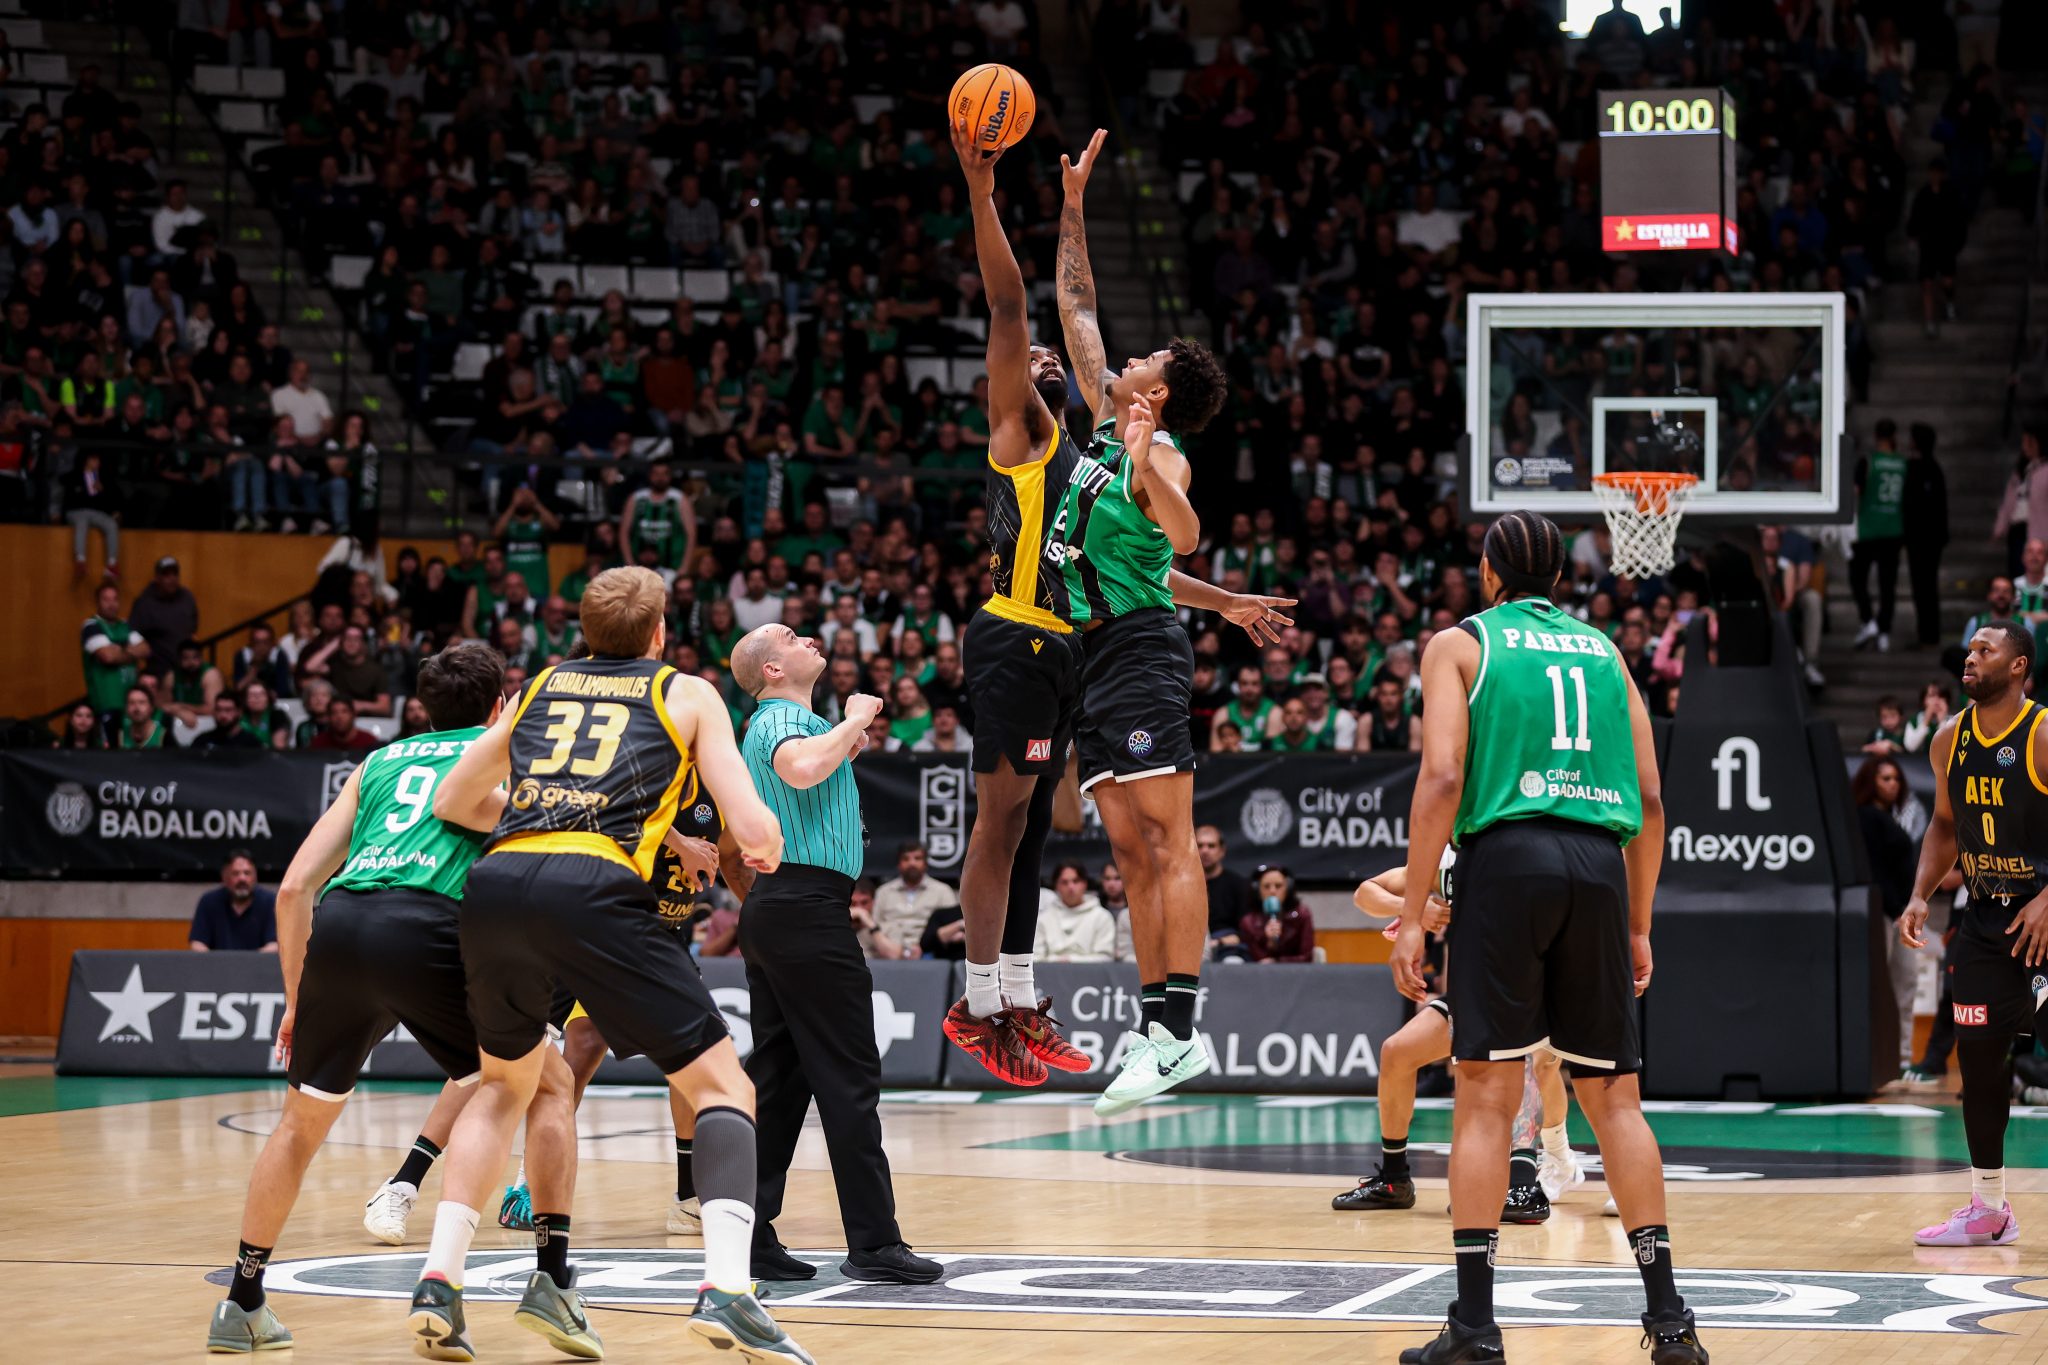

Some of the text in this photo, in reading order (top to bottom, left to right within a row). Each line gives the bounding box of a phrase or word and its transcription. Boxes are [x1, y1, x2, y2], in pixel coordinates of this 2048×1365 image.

[984, 90, 1010, 142] Wilson
[1606, 99, 1714, 132] 10:00
[1636, 223, 1710, 240] ESTRELLA
[1502, 628, 1609, 657] PARKER
[1545, 665, 1592, 752] 11
[528, 700, 631, 777] 33
[1546, 769, 1581, 785] City of
[1965, 775, 2005, 807] AEK
[99, 780, 178, 808] City of
[385, 764, 438, 834] 9
[541, 784, 610, 809] green
[1299, 787, 1384, 816] City of
[1548, 784, 1623, 805] BADALONA
[100, 810, 272, 839] BADALONA
[1981, 811, 1996, 846] 0
[358, 851, 437, 870] BADALONA
[1668, 826, 1815, 871] flexygo
[1954, 1004, 1986, 1024] AVIS
[1070, 1031, 1380, 1077] BALONA
